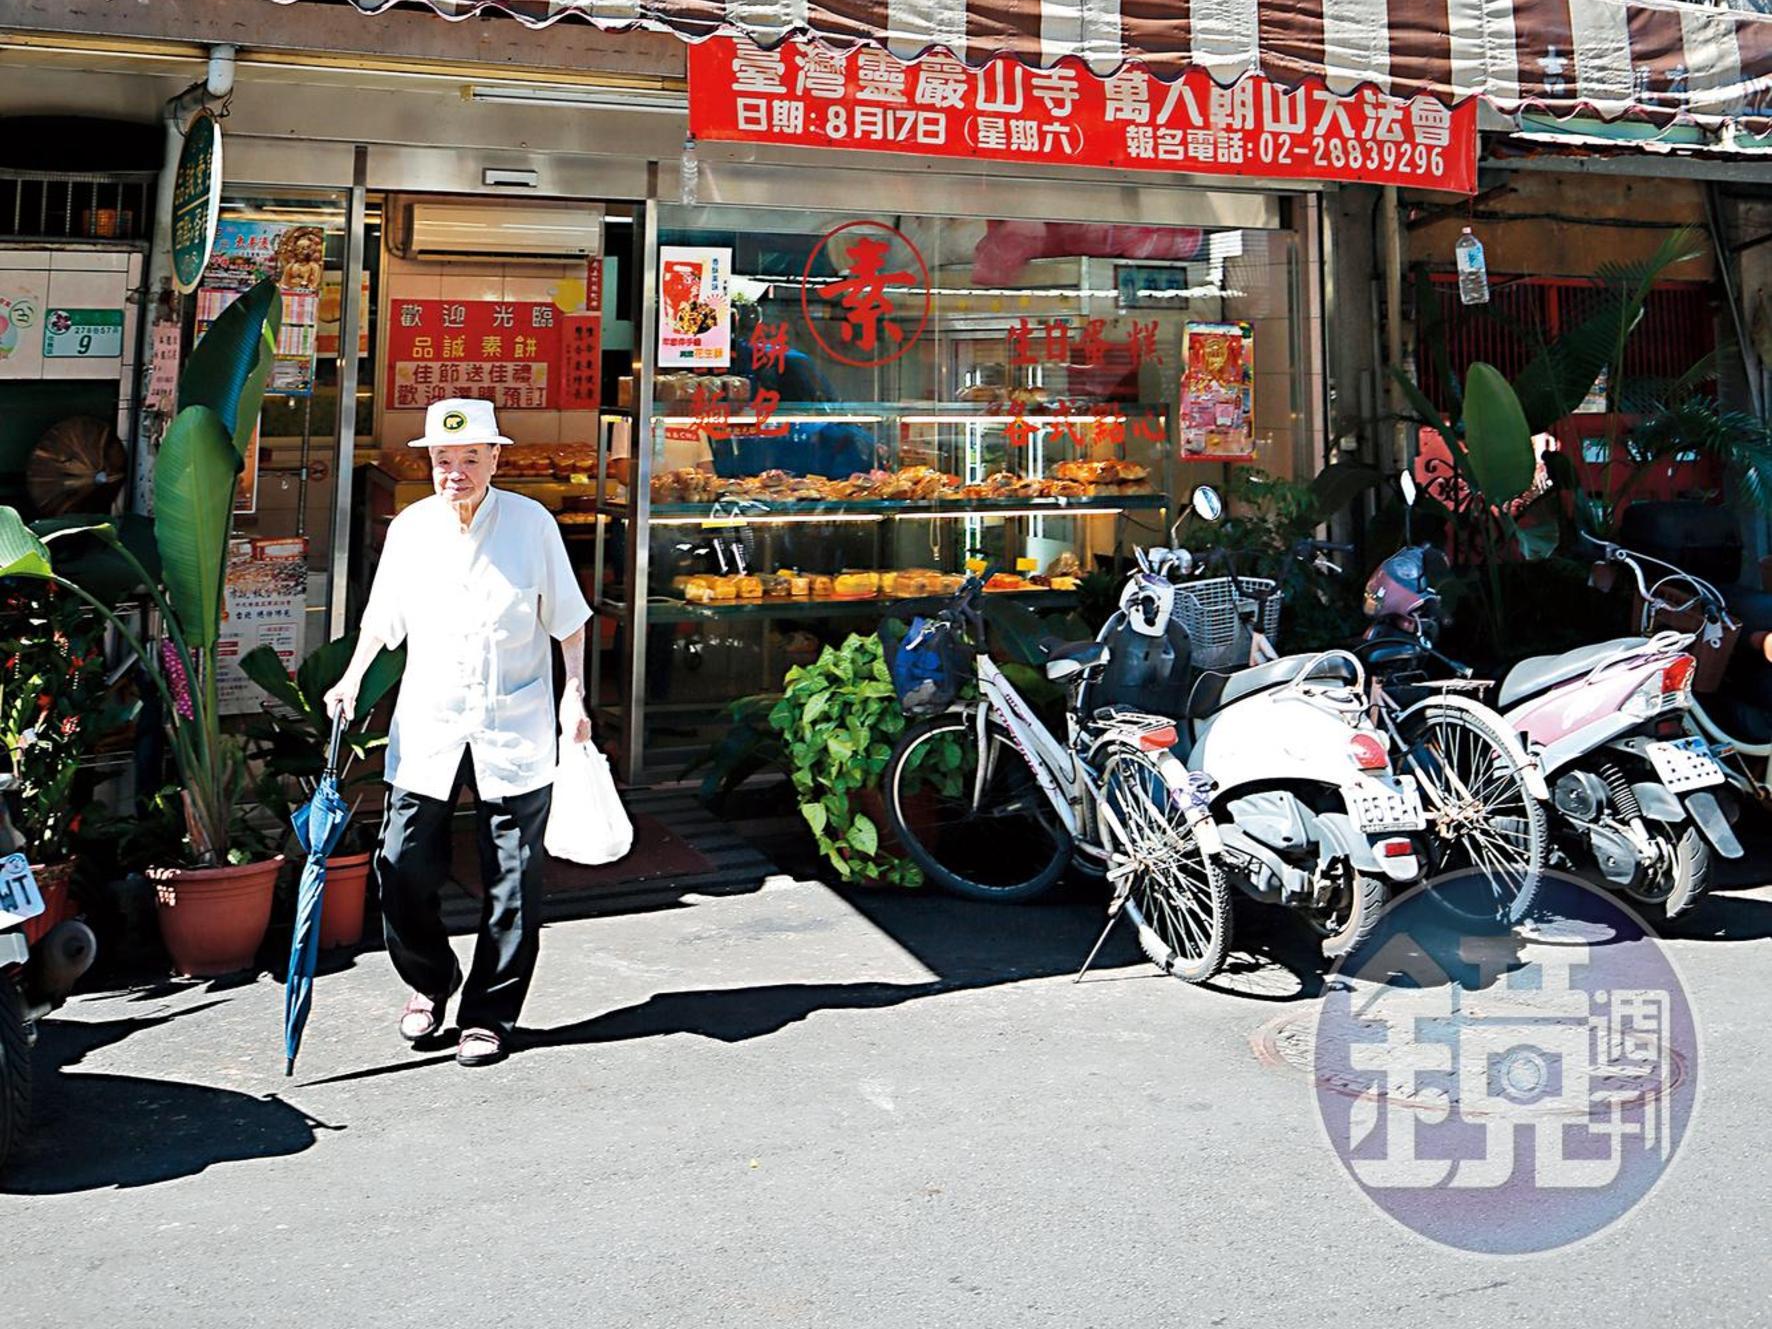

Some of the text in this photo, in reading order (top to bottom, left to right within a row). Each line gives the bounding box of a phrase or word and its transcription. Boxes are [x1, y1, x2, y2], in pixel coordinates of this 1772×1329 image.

[819, 237, 917, 352] 素
[401, 304, 553, 328] 歡迎光臨
[77, 334, 92, 354] 9
[412, 335, 537, 359] 品誠素餅
[412, 362, 533, 385] 佳節送佳禮
